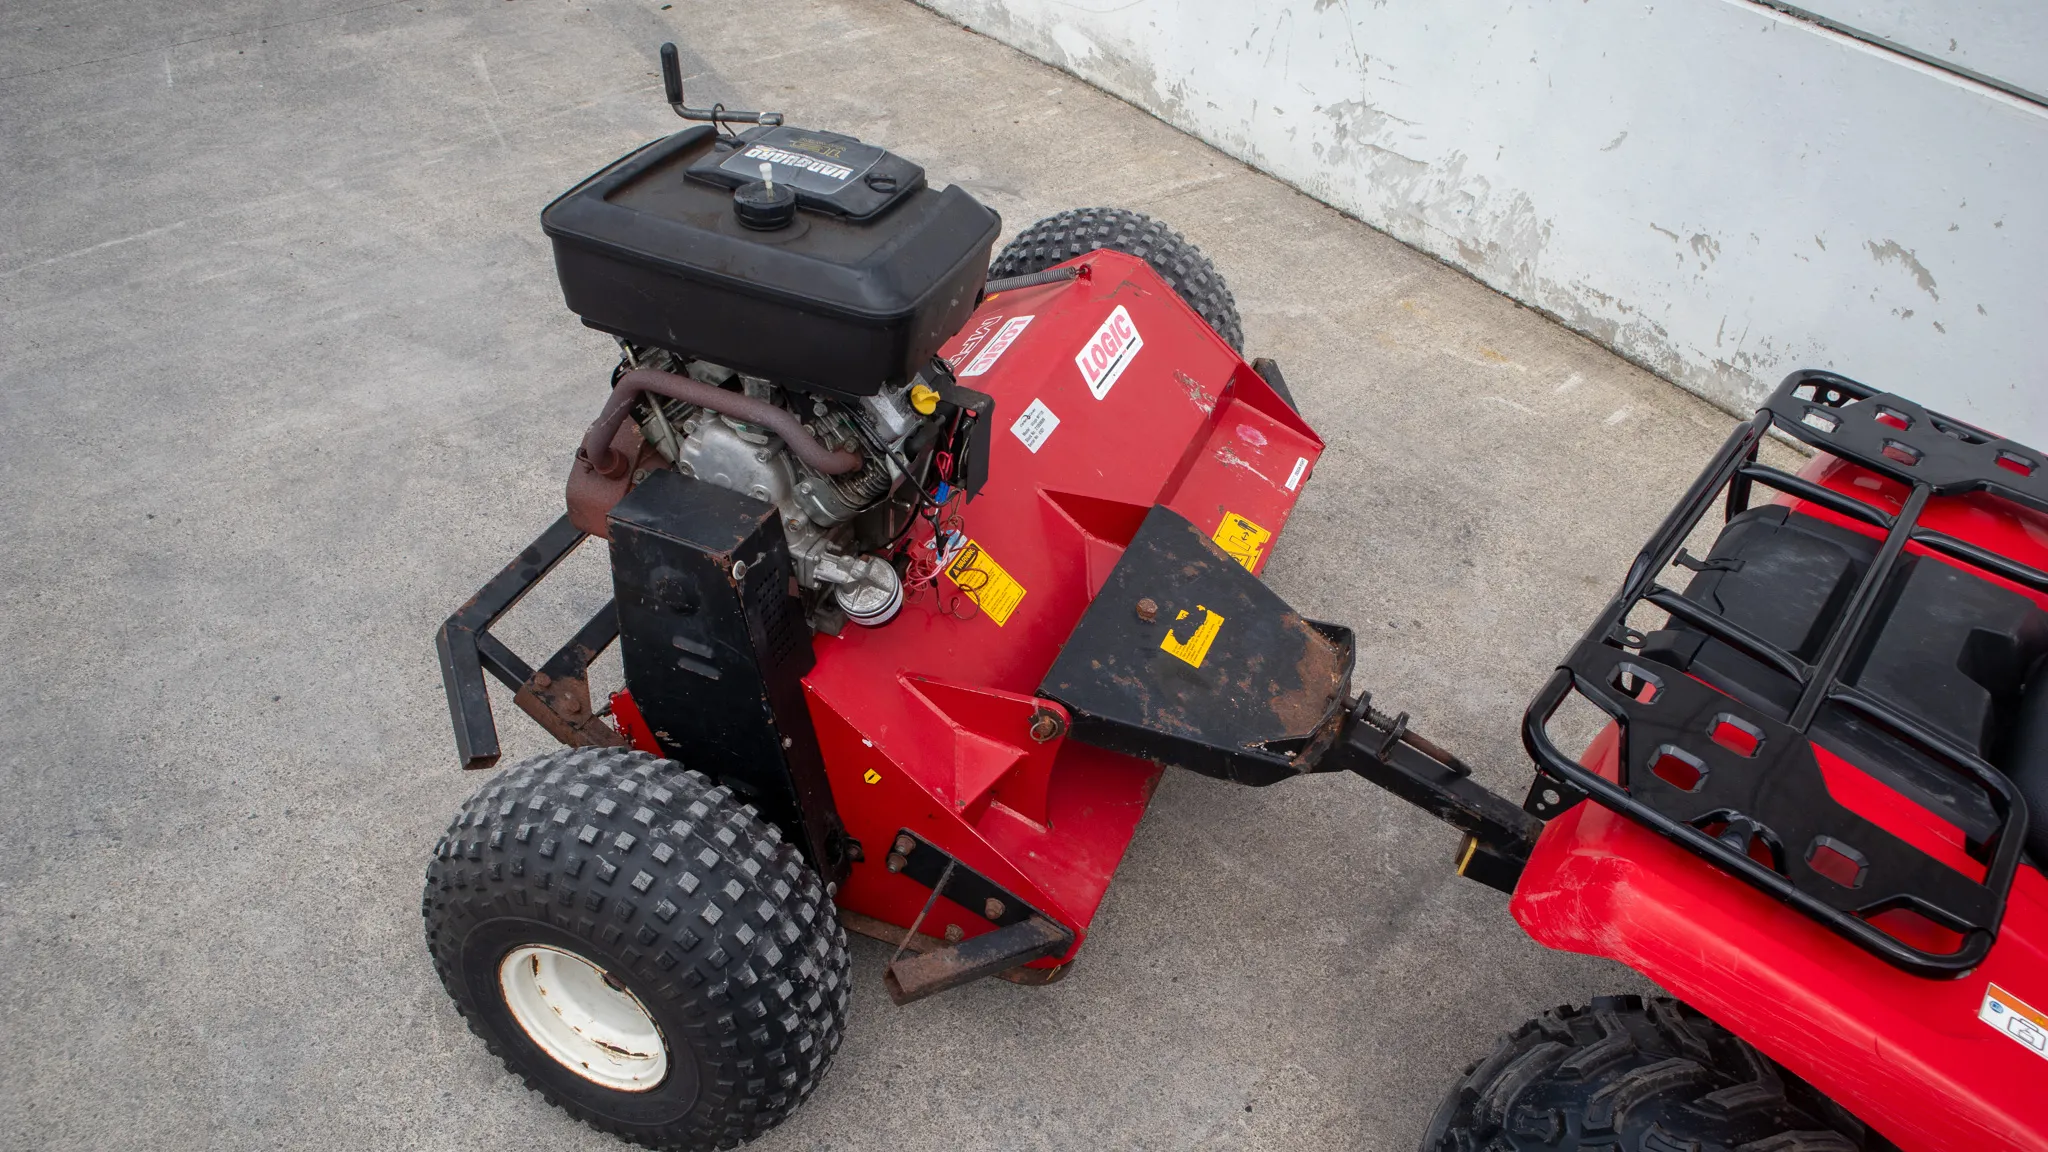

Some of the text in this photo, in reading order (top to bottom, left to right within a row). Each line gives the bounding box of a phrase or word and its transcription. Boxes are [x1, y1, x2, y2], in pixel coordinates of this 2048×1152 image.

[744, 148, 851, 180] VANGUARD
[971, 319, 1029, 371] LOGIC
[1081, 314, 1132, 383] LOGIC
